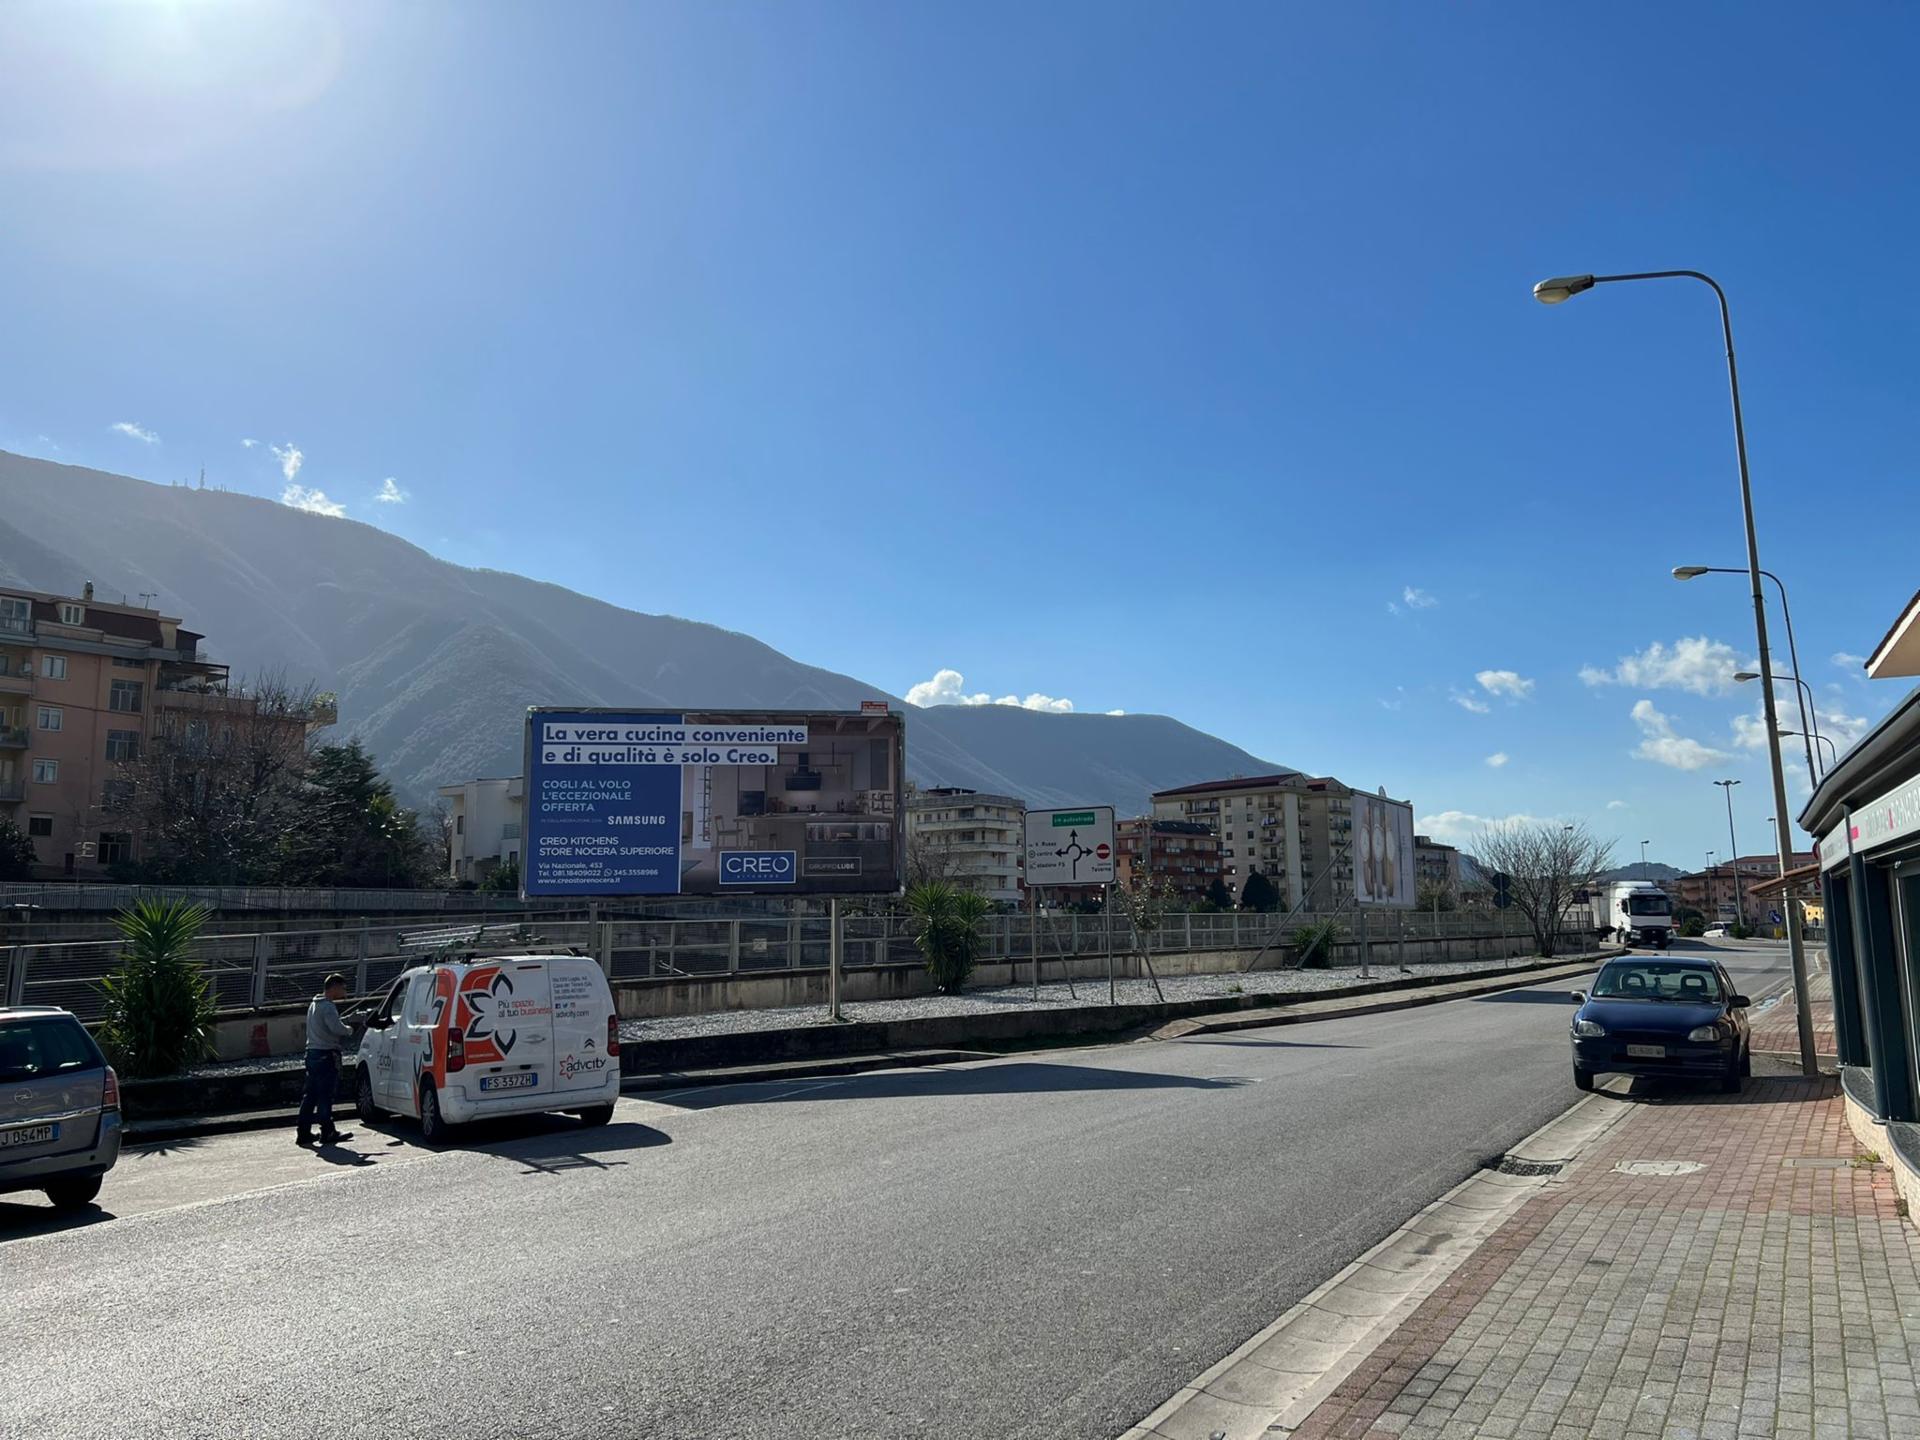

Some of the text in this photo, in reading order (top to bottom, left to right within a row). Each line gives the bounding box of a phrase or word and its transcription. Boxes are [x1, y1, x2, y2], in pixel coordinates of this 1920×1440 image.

[546, 726, 805, 742] La vera cucina conveniente
[544, 747, 775, 764] e di qualità è solo Creo.
[542, 780, 631, 789] COGLI AL VOLO
[542, 791, 632, 800] L'ECCEZIONALE
[541, 803, 595, 812] OFFERTA
[607, 816, 666, 825] SAMSUNG
[539, 836, 619, 846] CREO KITCHENS
[539, 846, 675, 856] STORE NOCERA SUPERIORE
[726, 856, 790, 873] CREO
[566, 1058, 606, 1072] advcity
